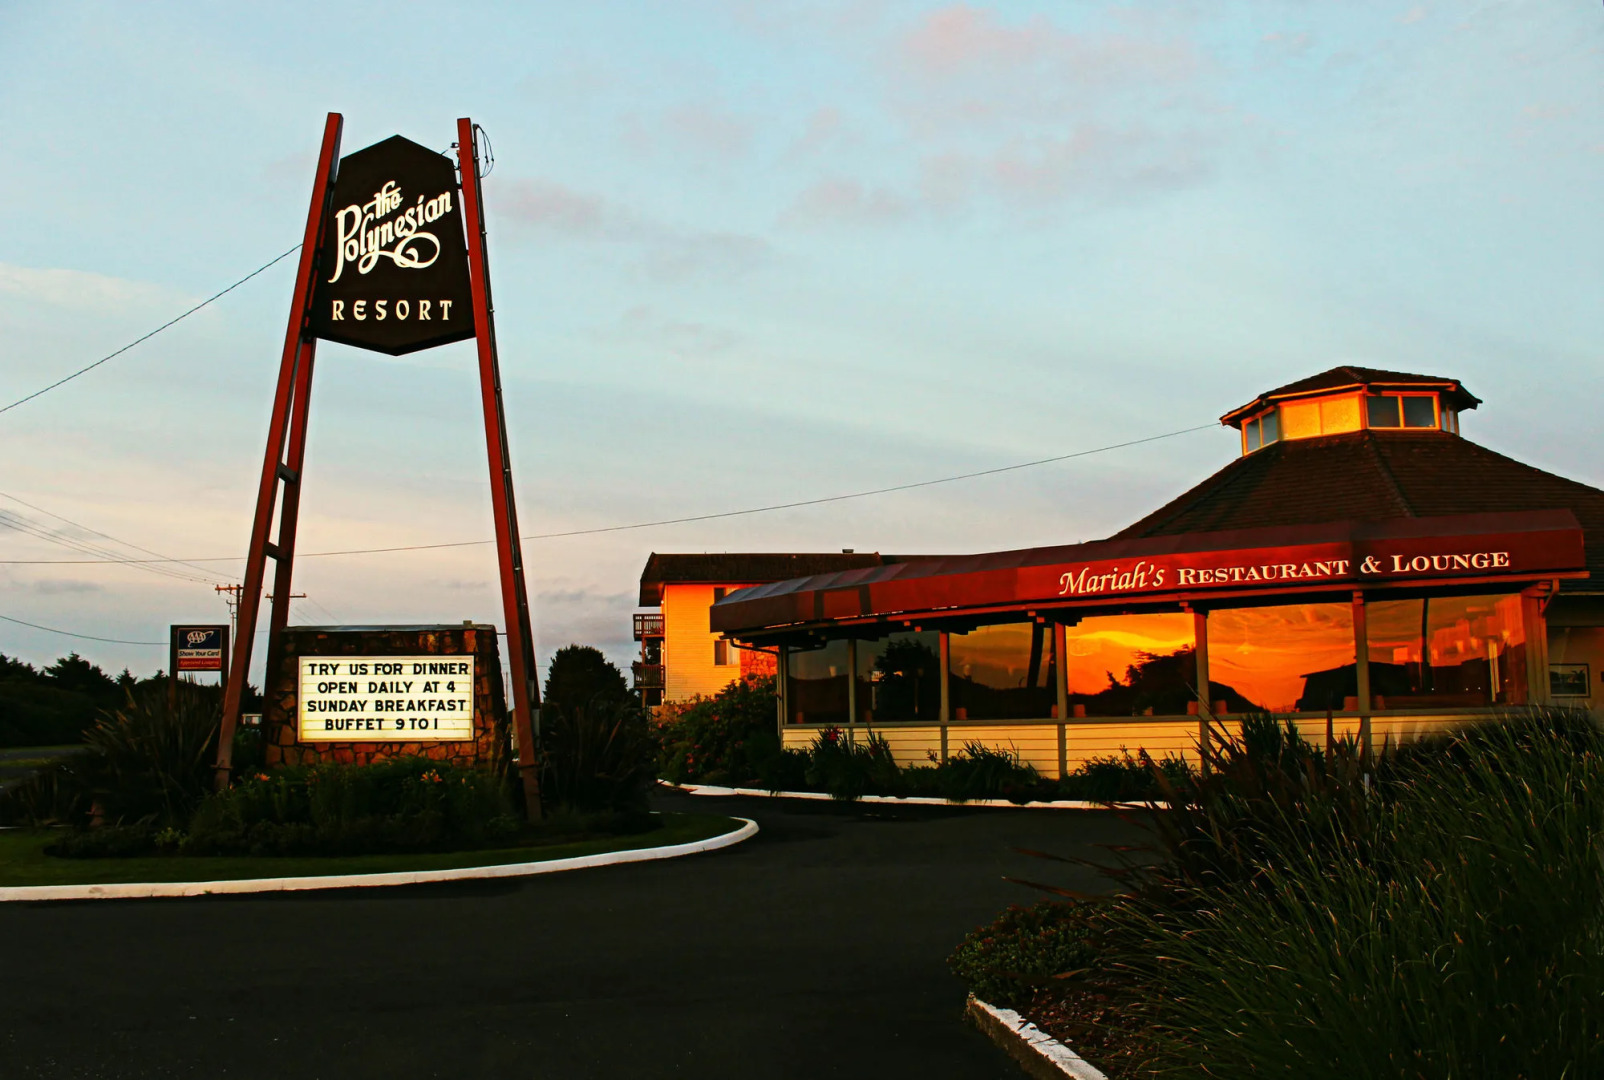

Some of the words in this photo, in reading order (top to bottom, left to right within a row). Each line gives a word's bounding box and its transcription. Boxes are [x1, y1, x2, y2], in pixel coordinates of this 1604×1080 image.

[363, 180, 404, 219] the
[327, 191, 453, 283] Polynesian
[331, 299, 453, 321] RESORT
[1058, 560, 1166, 596] Mariah's
[1176, 558, 1350, 587] RESTAURANT
[1359, 555, 1382, 574] &
[1390, 551, 1510, 574] LOUNGE
[308, 663, 340, 675] TRY
[349, 663, 368, 675] US
[374, 663, 403, 675] FOR
[413, 663, 469, 675] DINNER
[317, 682, 358, 693] OPEN
[368, 681, 413, 693] DAILY
[423, 681, 440, 693] AT
[446, 681, 456, 692] 4
[307, 700, 368, 712] SUNDAY
[374, 699, 466, 711] BREAKFAST
[325, 718, 385, 730] BUFFET
[395, 718, 405, 730] 9
[409, 718, 429, 730] TO
